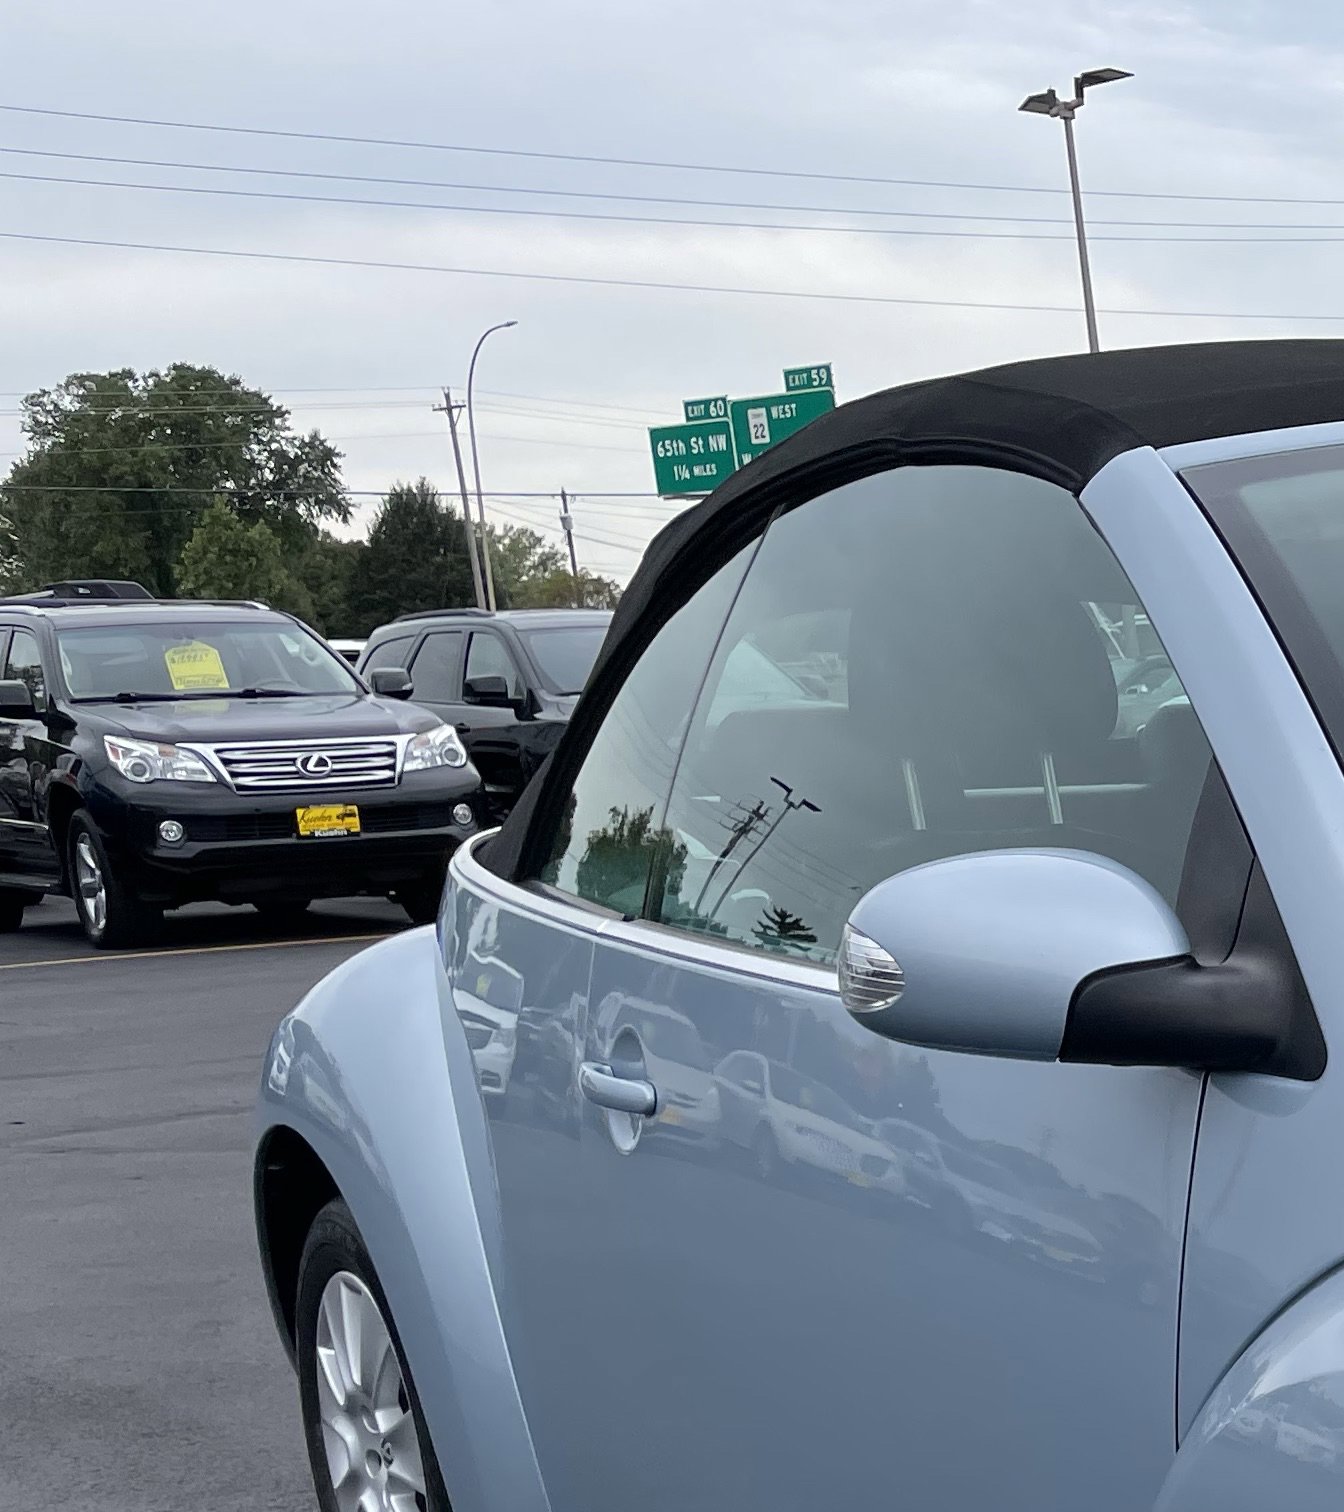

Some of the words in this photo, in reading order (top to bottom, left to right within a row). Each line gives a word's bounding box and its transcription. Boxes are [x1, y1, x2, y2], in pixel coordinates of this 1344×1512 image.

[788, 373, 808, 386] EXIT
[811, 368, 828, 386] 59
[687, 404, 705, 418] EXIT
[709, 400, 725, 417] 60
[771, 403, 797, 419] WEST
[753, 423, 767, 440] 22
[657, 439, 687, 457] 65th
[690, 436, 704, 454] St
[708, 433, 727, 452] NW
[693, 463, 717, 476] MILES
